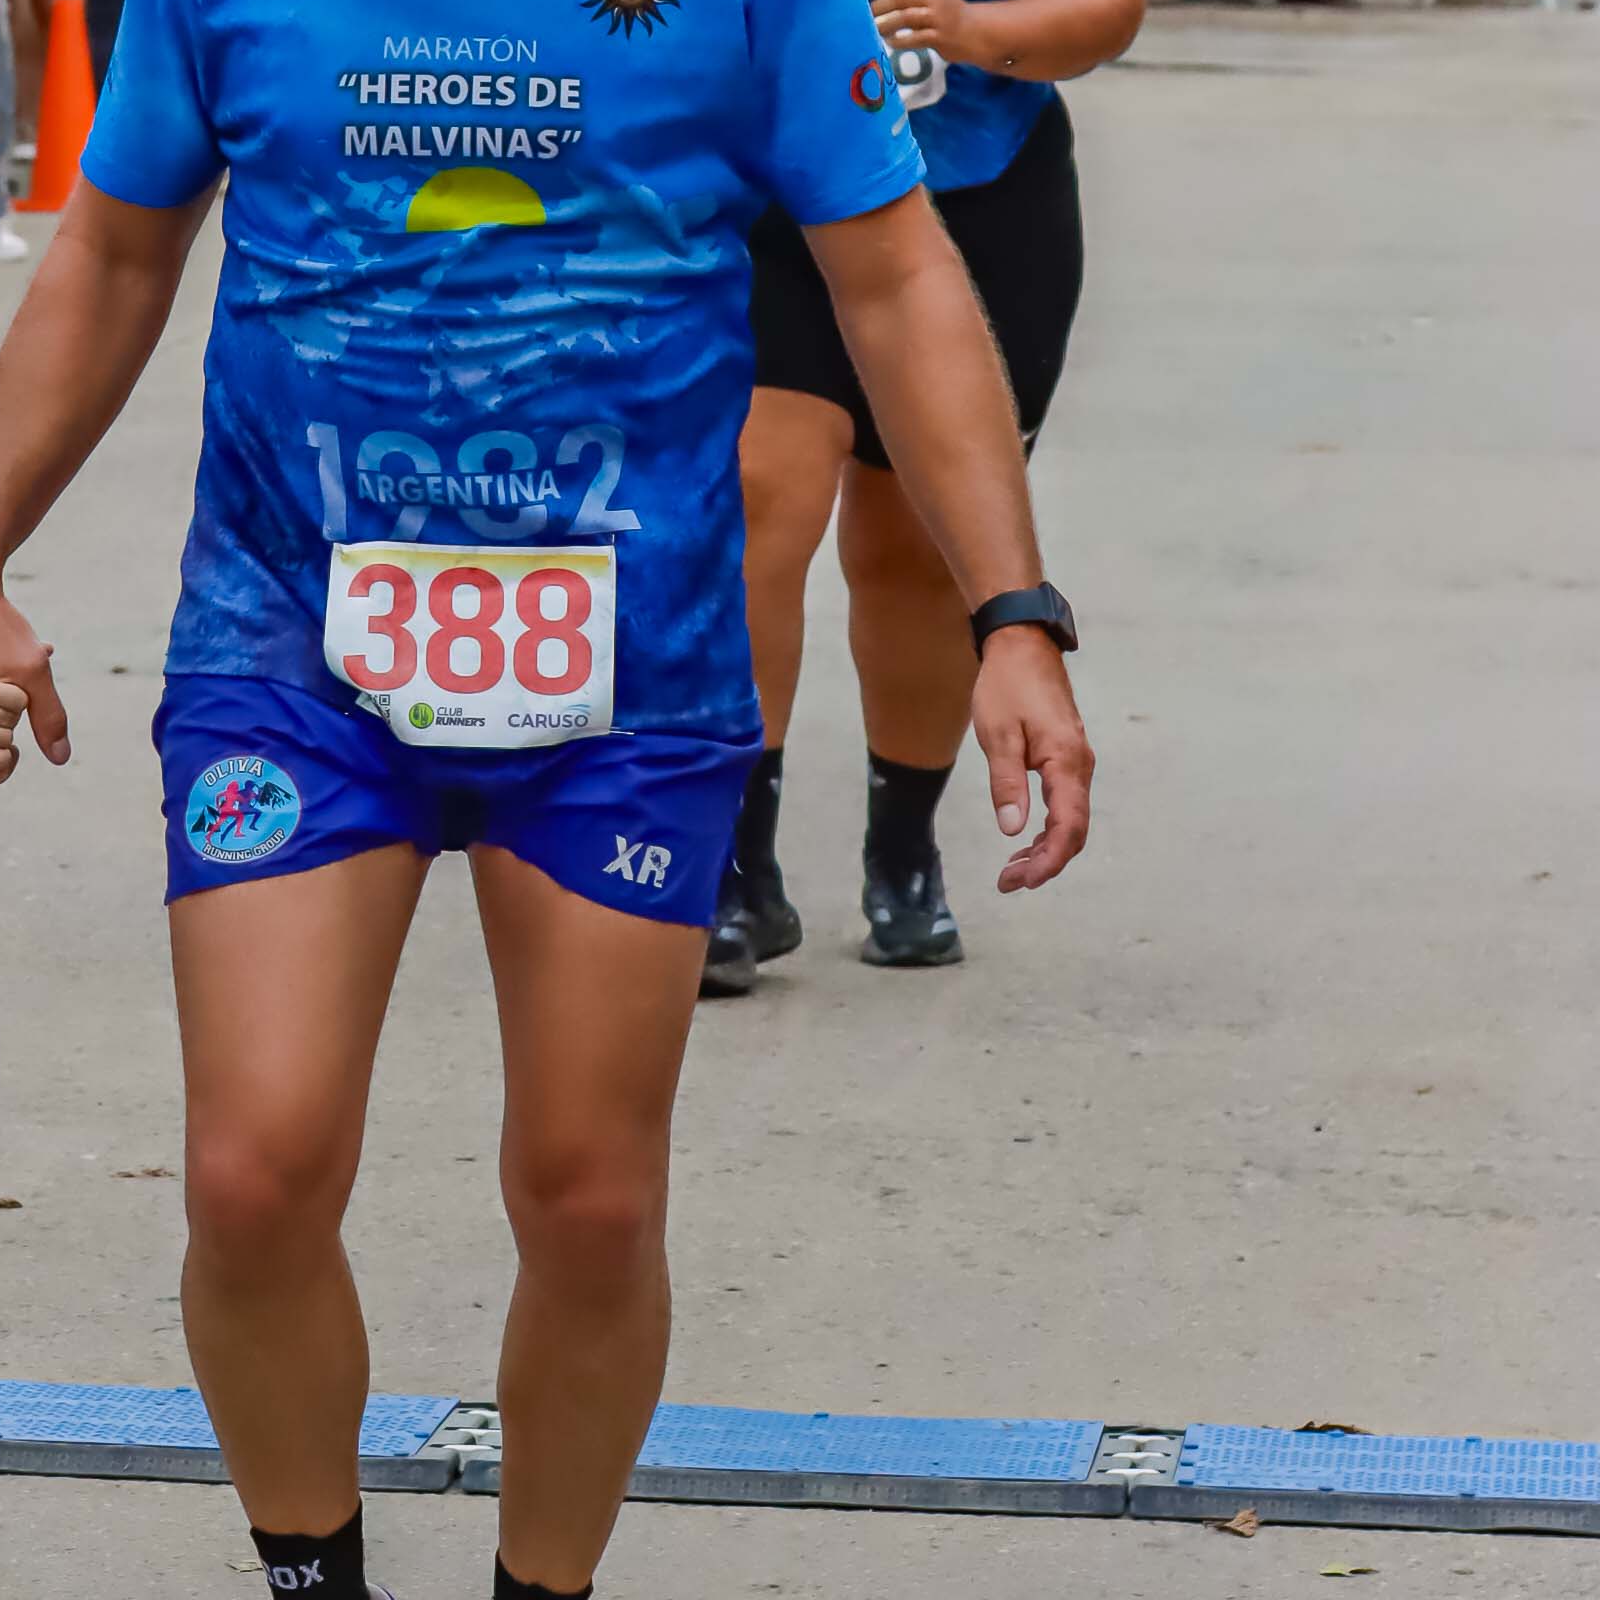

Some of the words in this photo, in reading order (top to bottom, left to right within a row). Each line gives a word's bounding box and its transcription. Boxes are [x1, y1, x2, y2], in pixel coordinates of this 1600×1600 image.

[383, 34, 538, 63] MARATÓN
[528, 77, 581, 109] DE
[306, 421, 642, 542] 1982
[357, 469, 561, 505] ARGENTINA
[343, 563, 592, 696] 388
[436, 706, 463, 717] CLUB
[508, 713, 589, 728] CARUSO
[204, 758, 263, 787] OLIVA
[203, 842, 252, 861] RUNNING
[253, 828, 285, 857] GROUP
[602, 834, 672, 889] XR
[262, 1559, 324, 1590] OX
